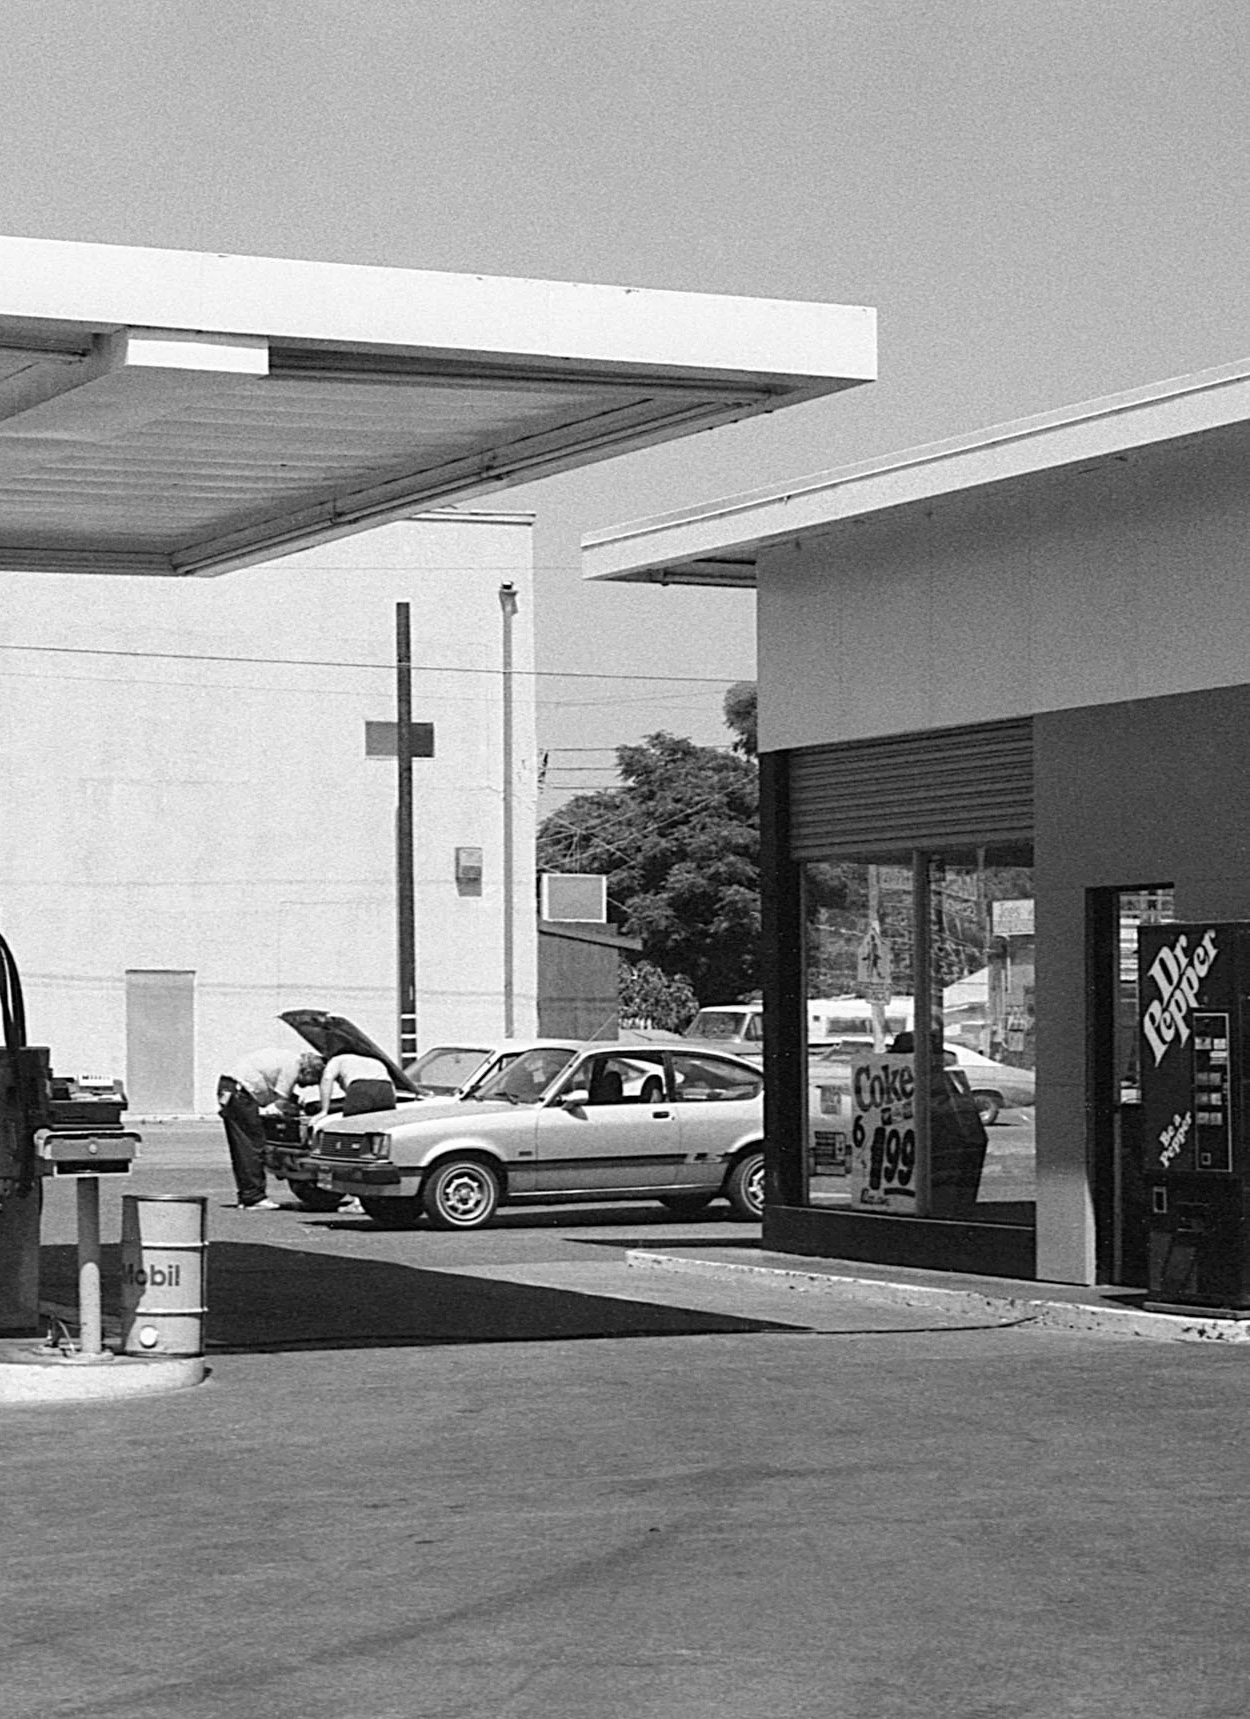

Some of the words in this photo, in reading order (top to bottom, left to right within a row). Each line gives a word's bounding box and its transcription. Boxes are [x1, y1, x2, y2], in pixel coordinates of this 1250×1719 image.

[1143, 929, 1219, 1068] Pepper
[1147, 934, 1190, 1009] Dr
[854, 1064, 914, 1112] Coke
[1159, 1111, 1192, 1168] Pepper
